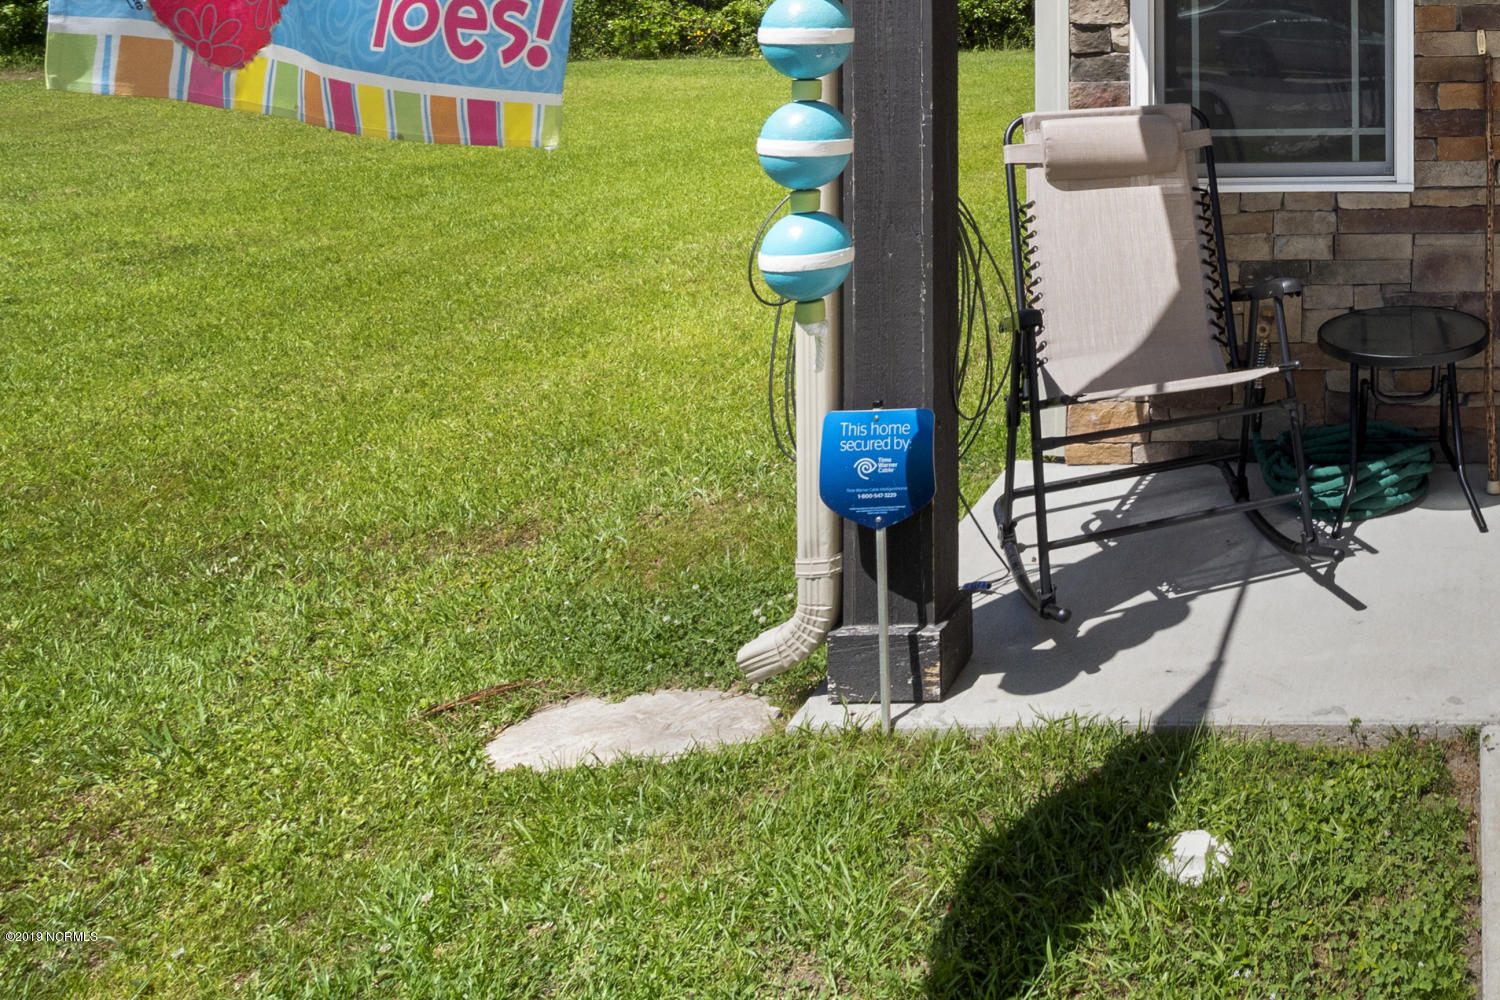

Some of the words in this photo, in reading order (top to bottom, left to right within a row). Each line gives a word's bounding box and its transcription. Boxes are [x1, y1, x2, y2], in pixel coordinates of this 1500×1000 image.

[840, 422, 867, 437] This
[870, 422, 911, 436] home
[840, 436, 890, 451] secured
[893, 436, 912, 452] by:
